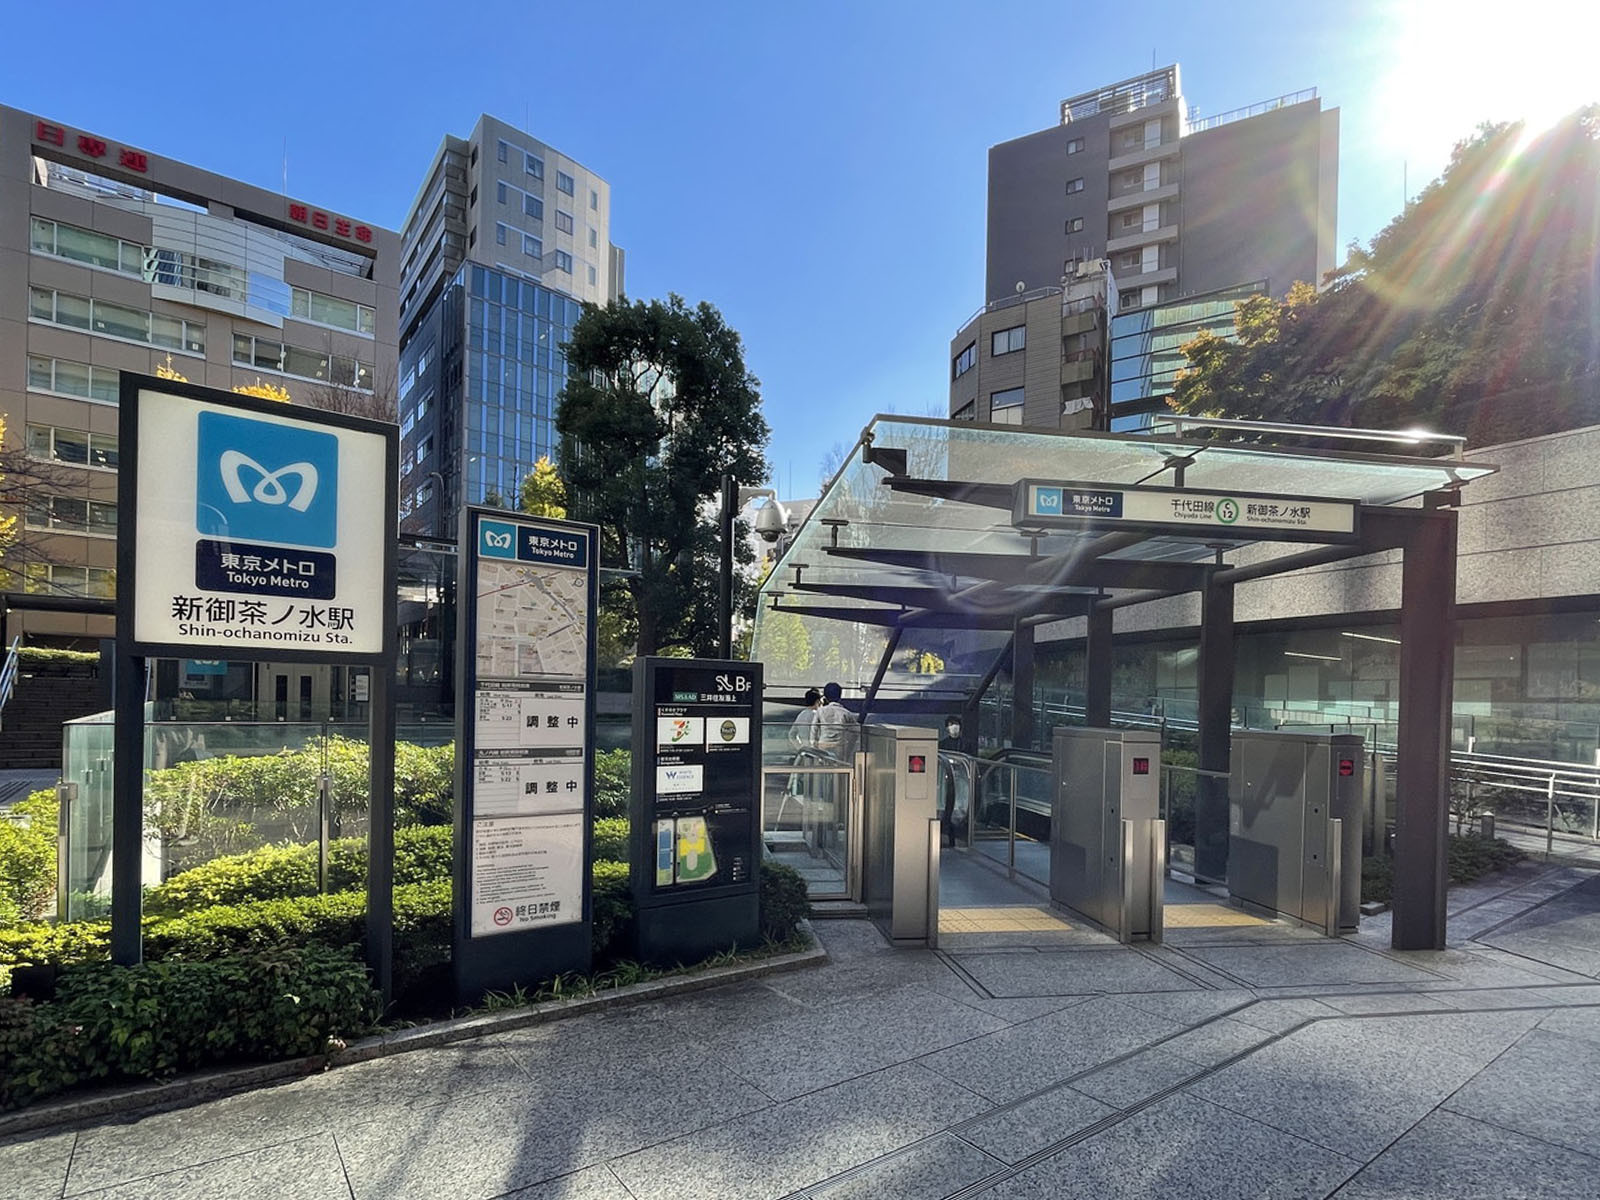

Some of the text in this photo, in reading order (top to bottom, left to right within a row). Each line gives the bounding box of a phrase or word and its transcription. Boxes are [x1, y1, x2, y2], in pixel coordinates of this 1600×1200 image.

[289, 204, 372, 243] 朝日生命
[1072, 495, 1113, 505] 東京メトロ
[1171, 498, 1215, 513] 千代田線
[1224, 502, 1231, 510] C
[1074, 504, 1111, 514] Tokyo Metro
[1174, 511, 1199, 519] Chiyoda
[1222, 510, 1233, 518] 12
[1247, 503, 1311, 519] 新御茶ノ水駅
[1247, 515, 1296, 525] Shin-ochanomizu
[528, 536, 577, 551] 東京メトロ
[531, 546, 575, 559] Tokyo Metro
[220, 553, 315, 577] 東京メトロ
[226, 571, 310, 590] Tokyo Metro
[172, 595, 354, 631] 新御茶ノ水駅
[178, 623, 353, 645] Shin-ochanomizu Sta.
[526, 715, 579, 729] 調整中
[525, 780, 578, 795] 調整中
[515, 900, 561, 917] 終日禁煙
[530, 912, 557, 921] Smoking
